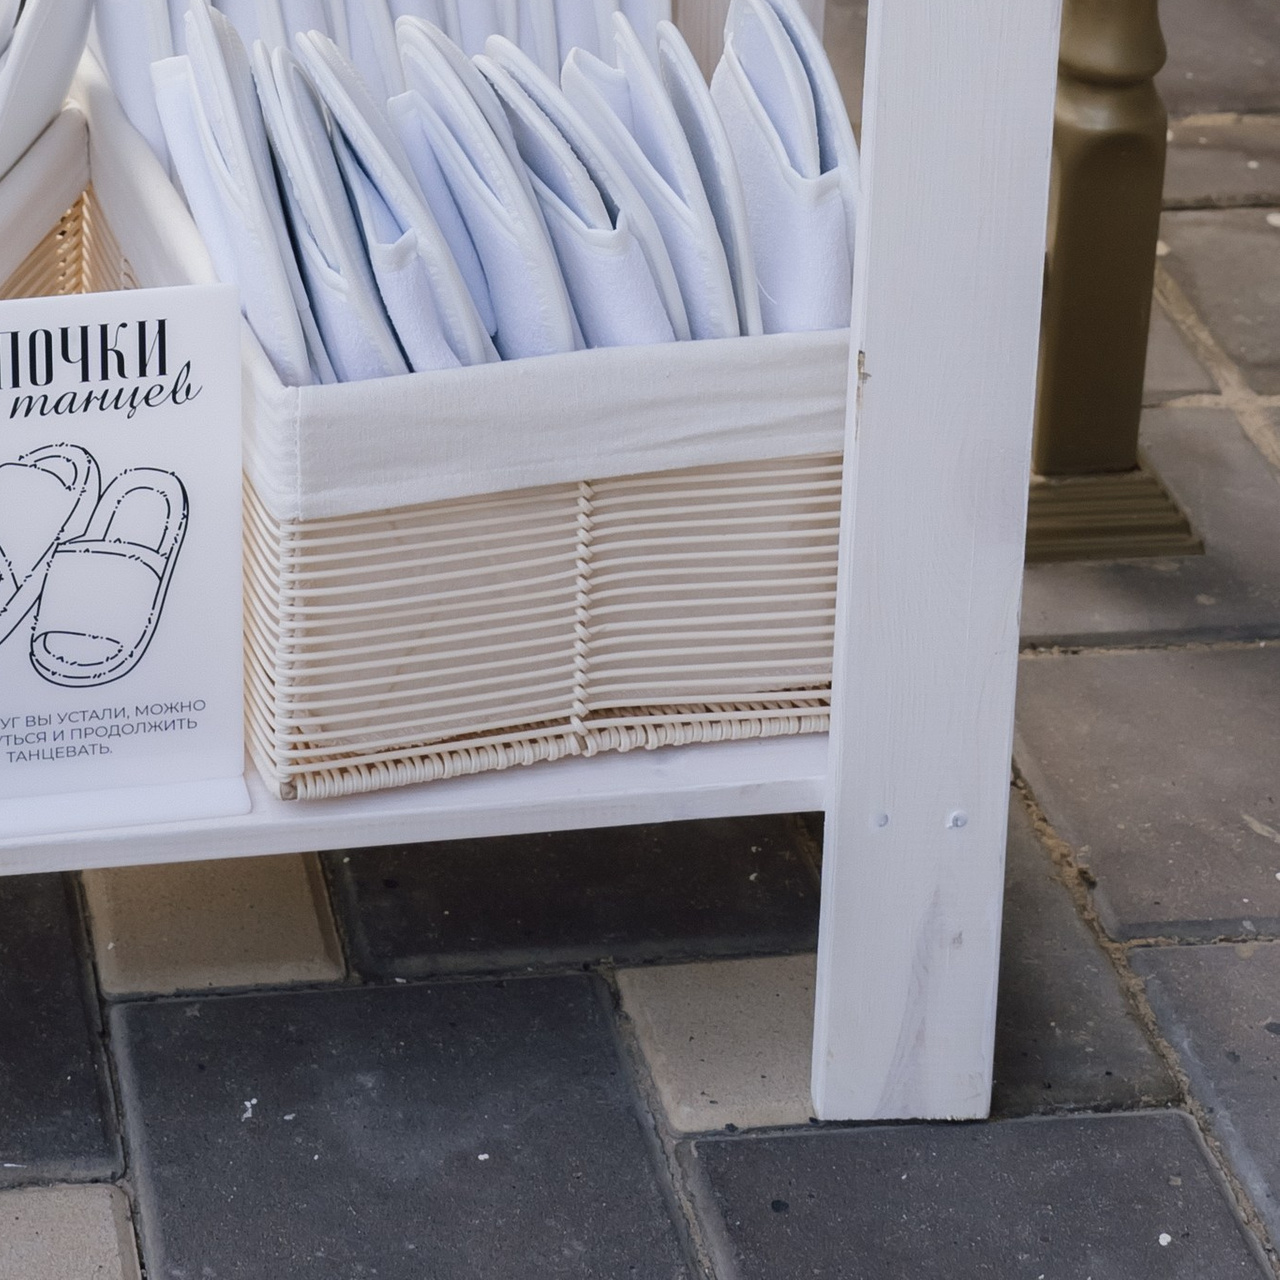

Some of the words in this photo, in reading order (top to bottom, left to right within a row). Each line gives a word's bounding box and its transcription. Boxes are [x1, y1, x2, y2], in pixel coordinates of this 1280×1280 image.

[9, 360, 204, 421] танцев
[25, 713, 53, 728] ВЫ
[56, 706, 131, 724] УСТАЛИ,
[135, 699, 207, 717] МОЖНО
[52, 729, 65, 742] И
[70, 718, 199, 741] ПРОДОЛЖИТЬ
[6, 743, 114, 764] ТАНЦЕВАТЬ.
